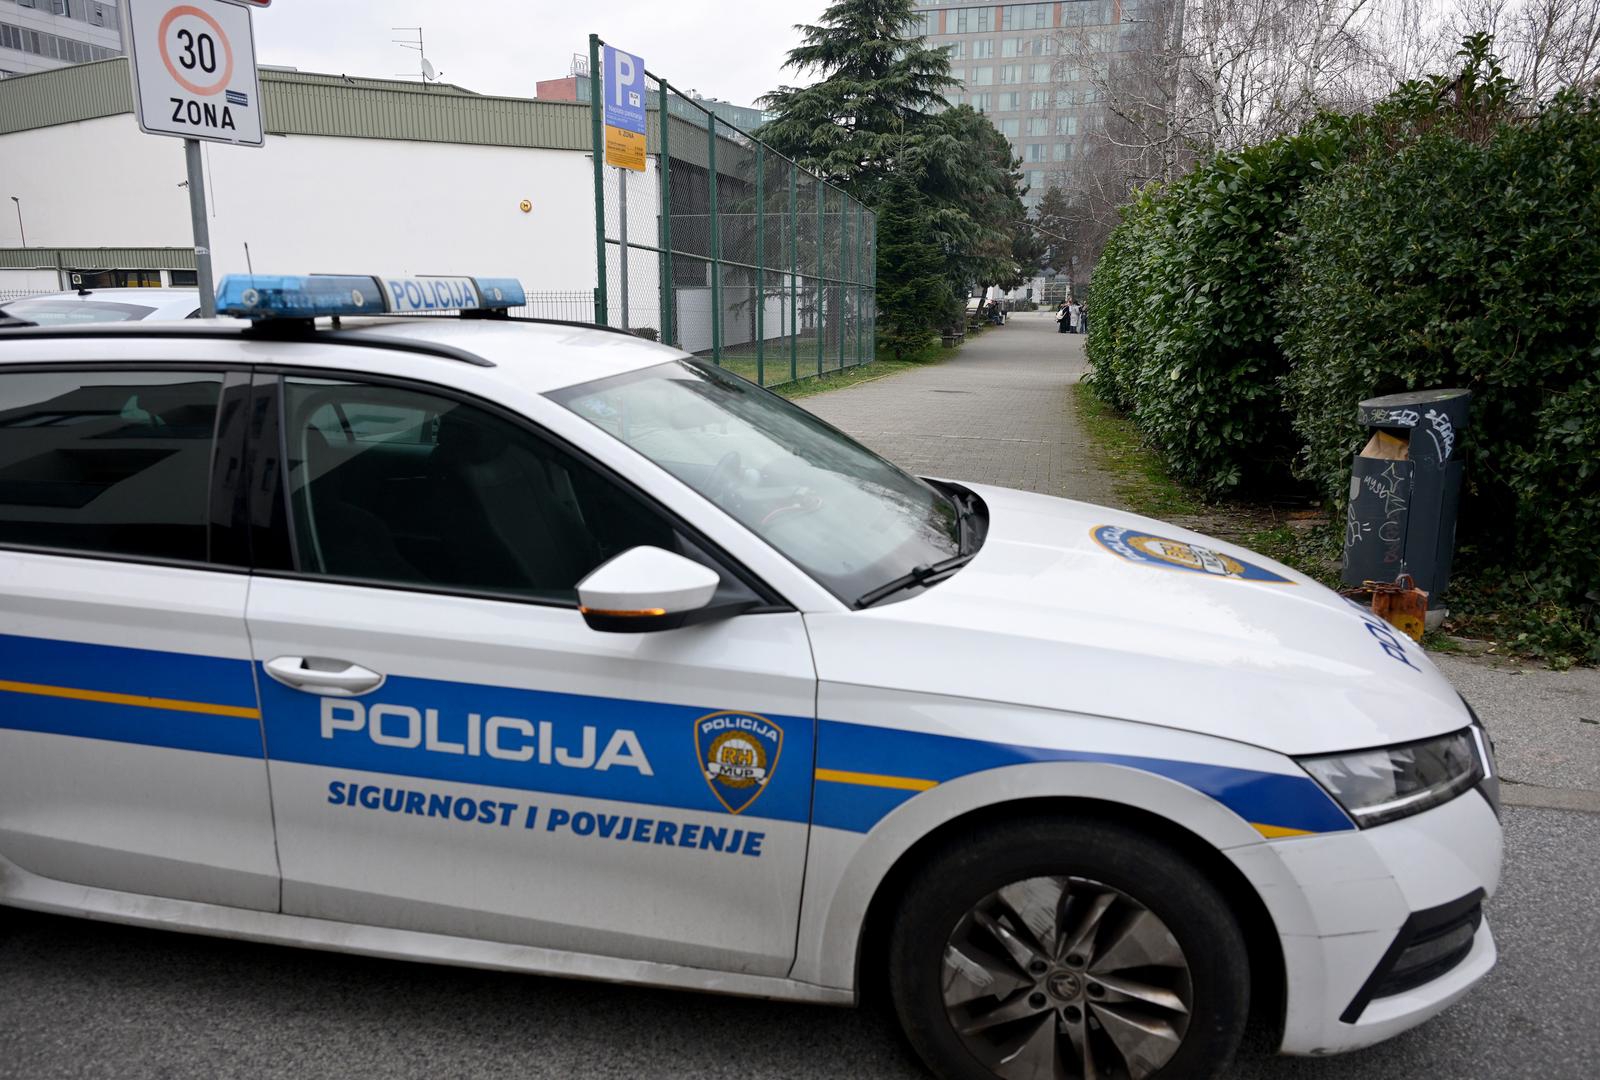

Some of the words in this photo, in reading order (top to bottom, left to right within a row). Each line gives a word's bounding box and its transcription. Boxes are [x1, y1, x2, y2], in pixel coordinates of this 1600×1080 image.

[177, 29, 217, 73] 30
[615, 50, 636, 107] P
[169, 97, 236, 131] ZONA
[388, 280, 476, 310] POLICIJA
[320, 696, 655, 777] POLICIJA
[701, 717, 778, 743] POLICIJA
[720, 765, 755, 779] MUP
[721, 746, 754, 767] RH
[327, 780, 518, 828] SIGURNOST
[525, 806, 539, 830] I
[546, 808, 766, 857] POVJERENJE
